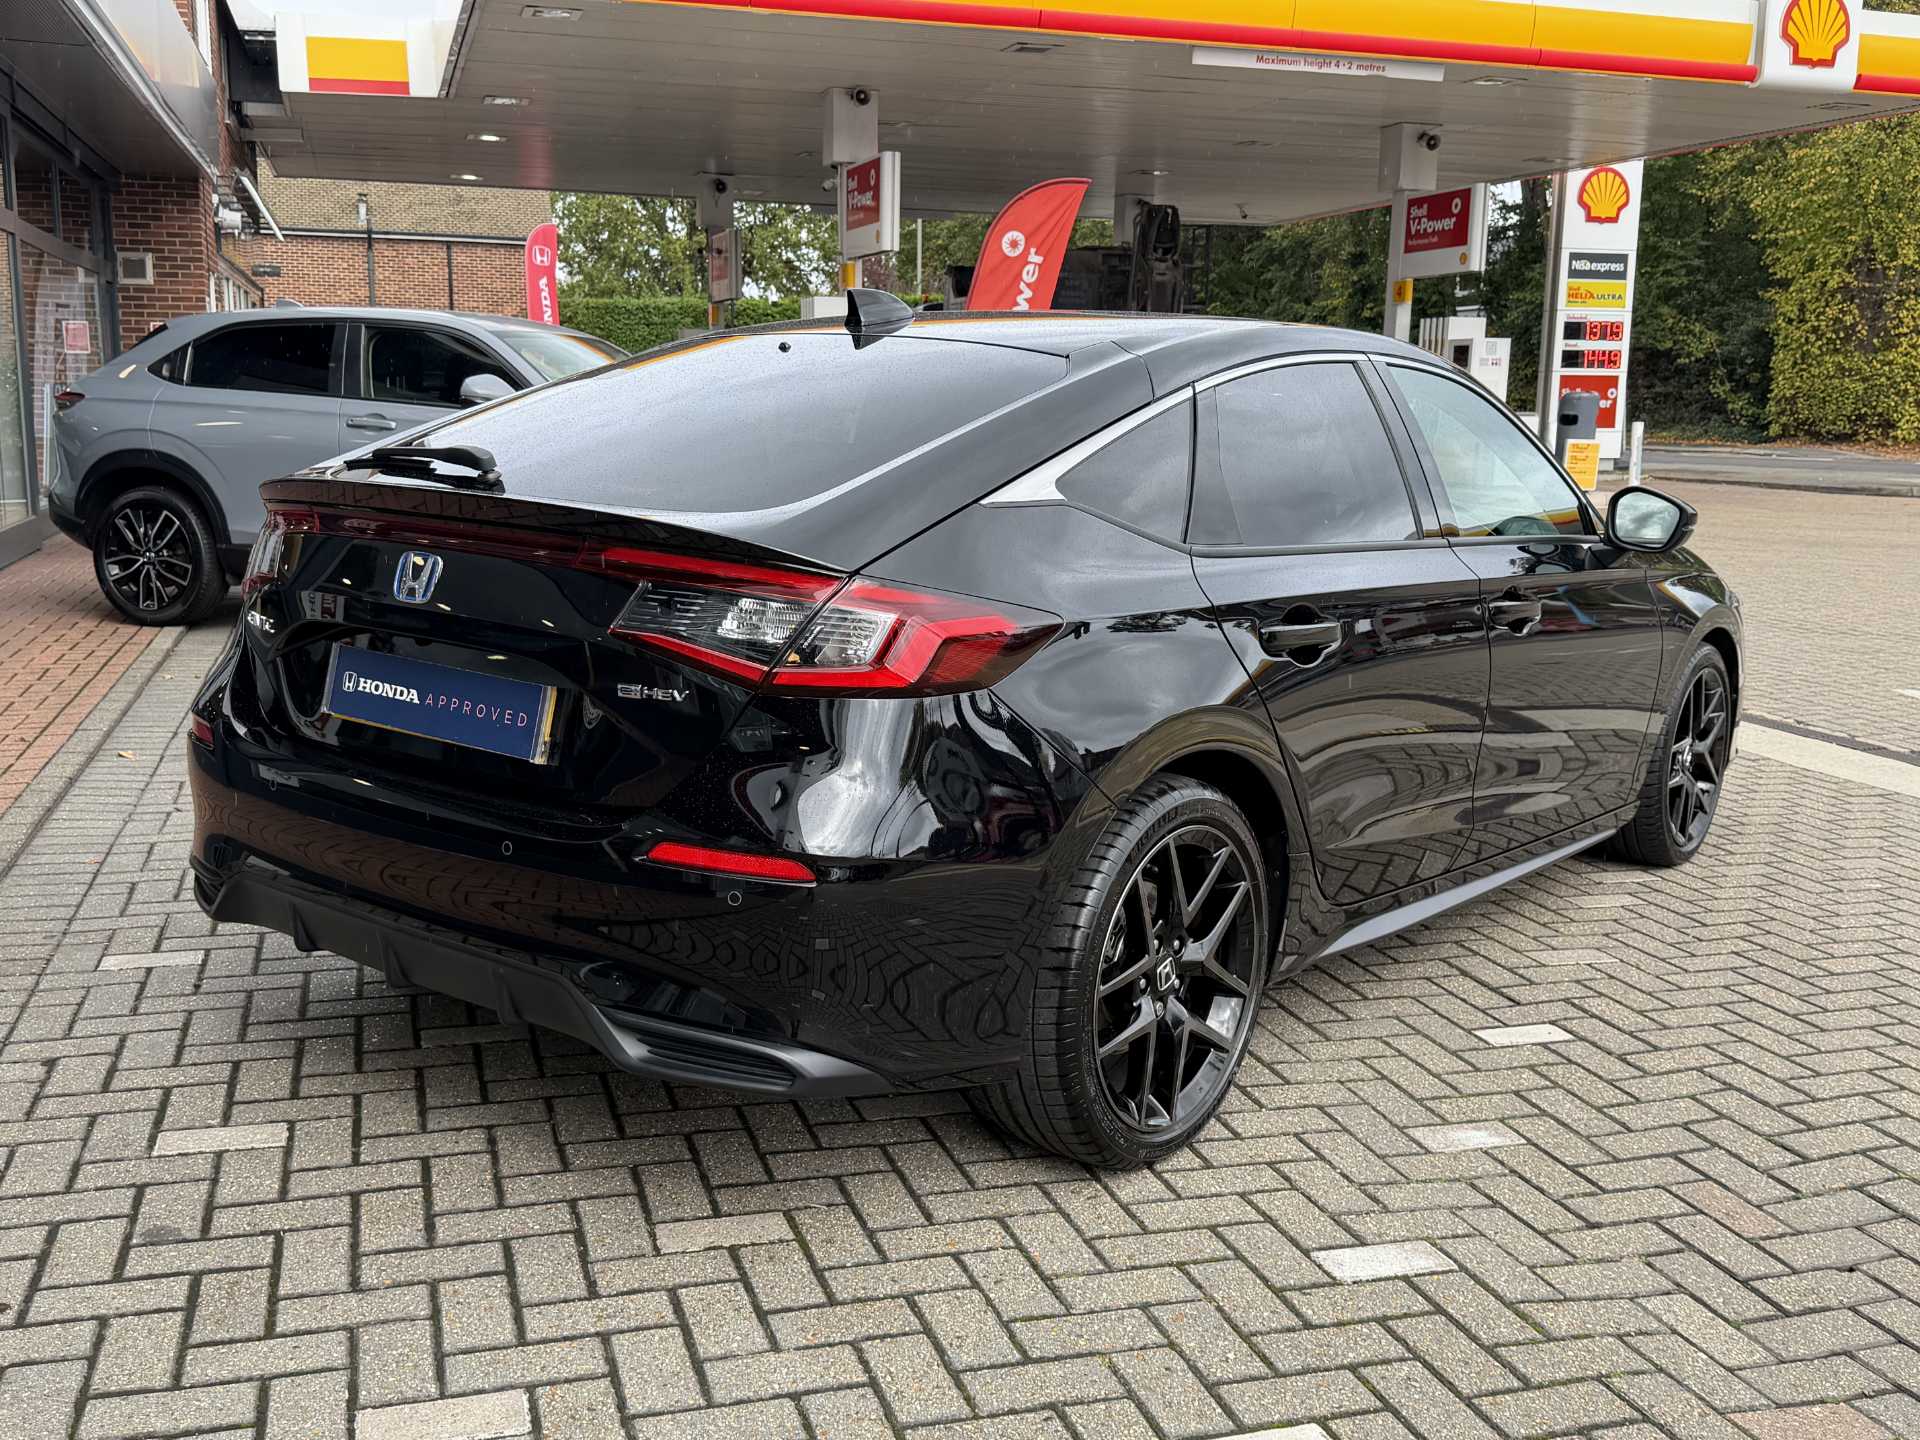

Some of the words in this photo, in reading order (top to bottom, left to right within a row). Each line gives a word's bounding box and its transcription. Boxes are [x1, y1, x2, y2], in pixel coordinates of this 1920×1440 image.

[1255, 54, 1301, 67] Maximum
[1303, 56, 1332, 70] height
[1356, 63, 1387, 73] metres
[1409, 203, 1428, 218] Shell
[1409, 216, 1457, 235] V-Power
[538, 275, 554, 323] NDA
[1596, 293, 1623, 301] ULTRA
[357, 677, 420, 704] HONDA
[425, 692, 528, 727] APPROVED
